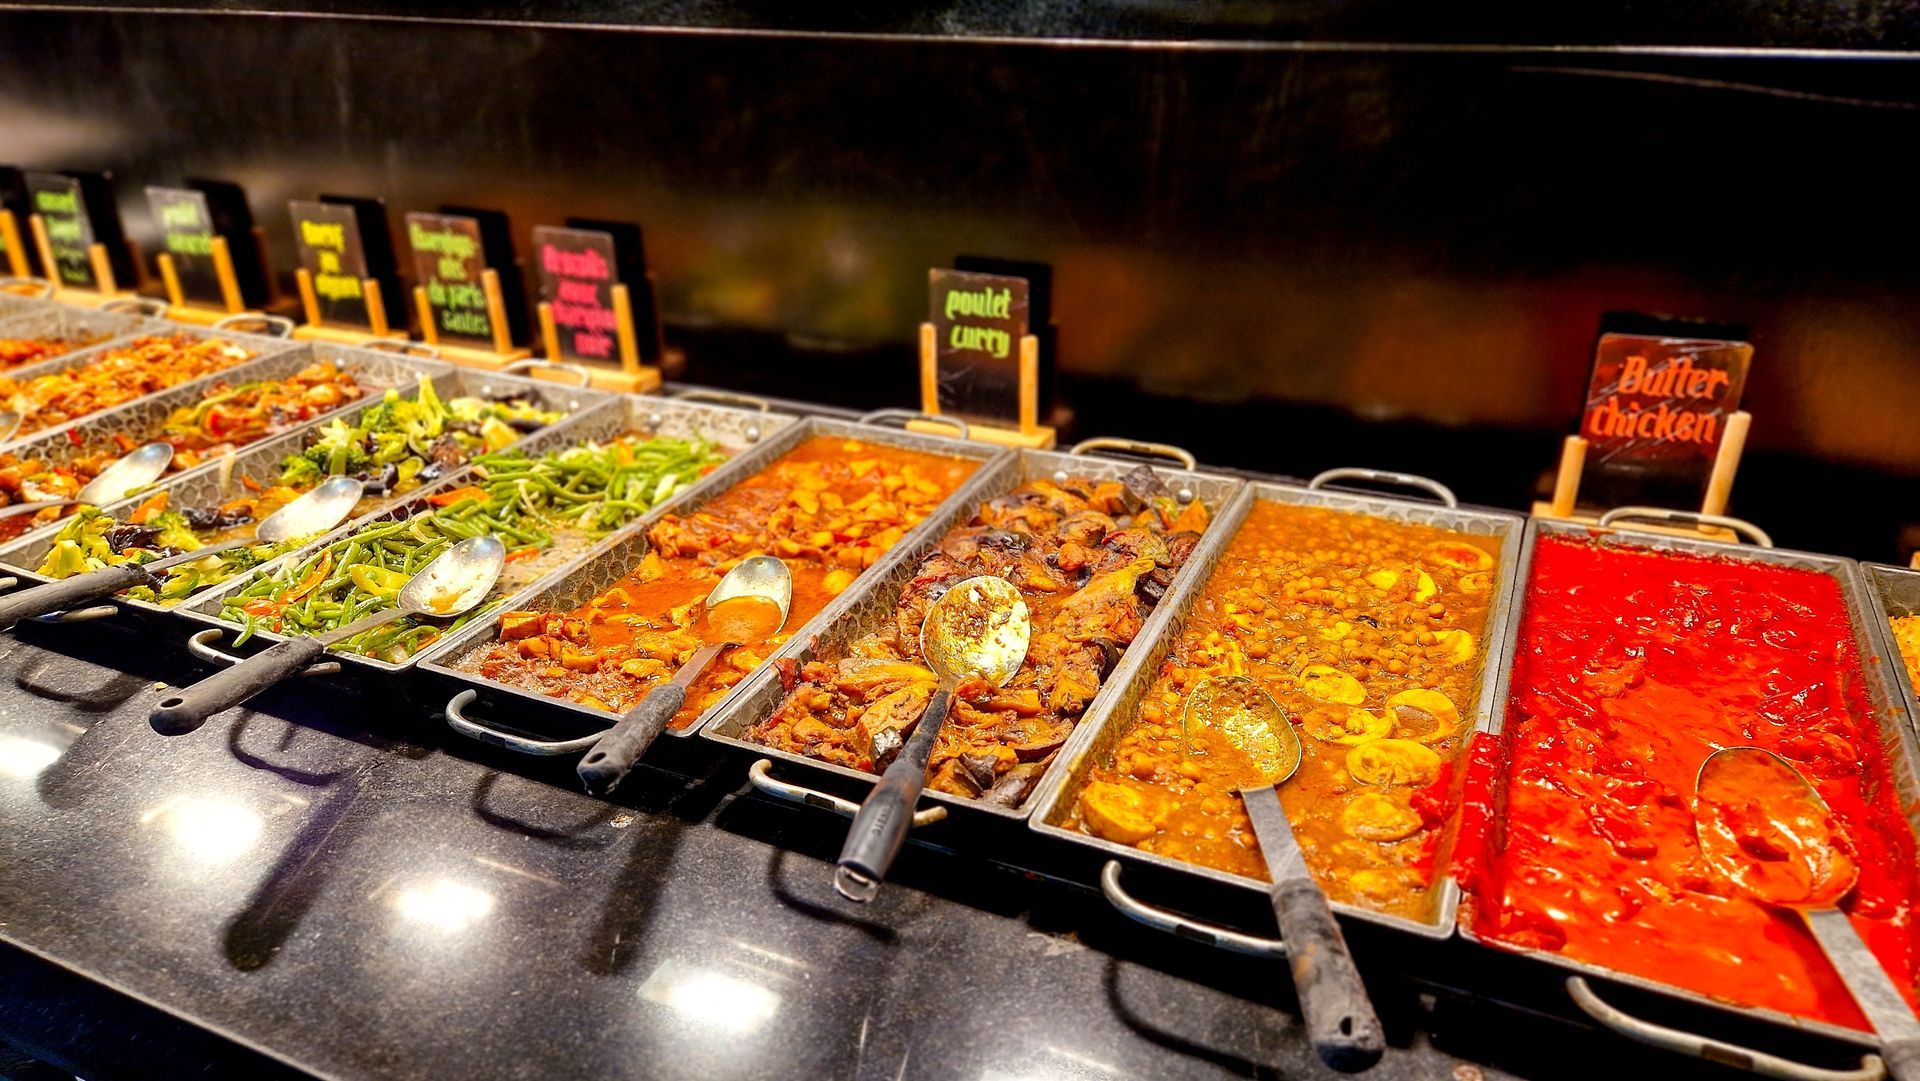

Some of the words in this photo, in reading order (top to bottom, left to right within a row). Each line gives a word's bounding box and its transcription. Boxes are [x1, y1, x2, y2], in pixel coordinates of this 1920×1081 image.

[945, 286, 1012, 320] poulet
[950, 324, 1010, 358] curry
[1617, 355, 1729, 400] Butter
[1589, 396, 1717, 444] chicken
